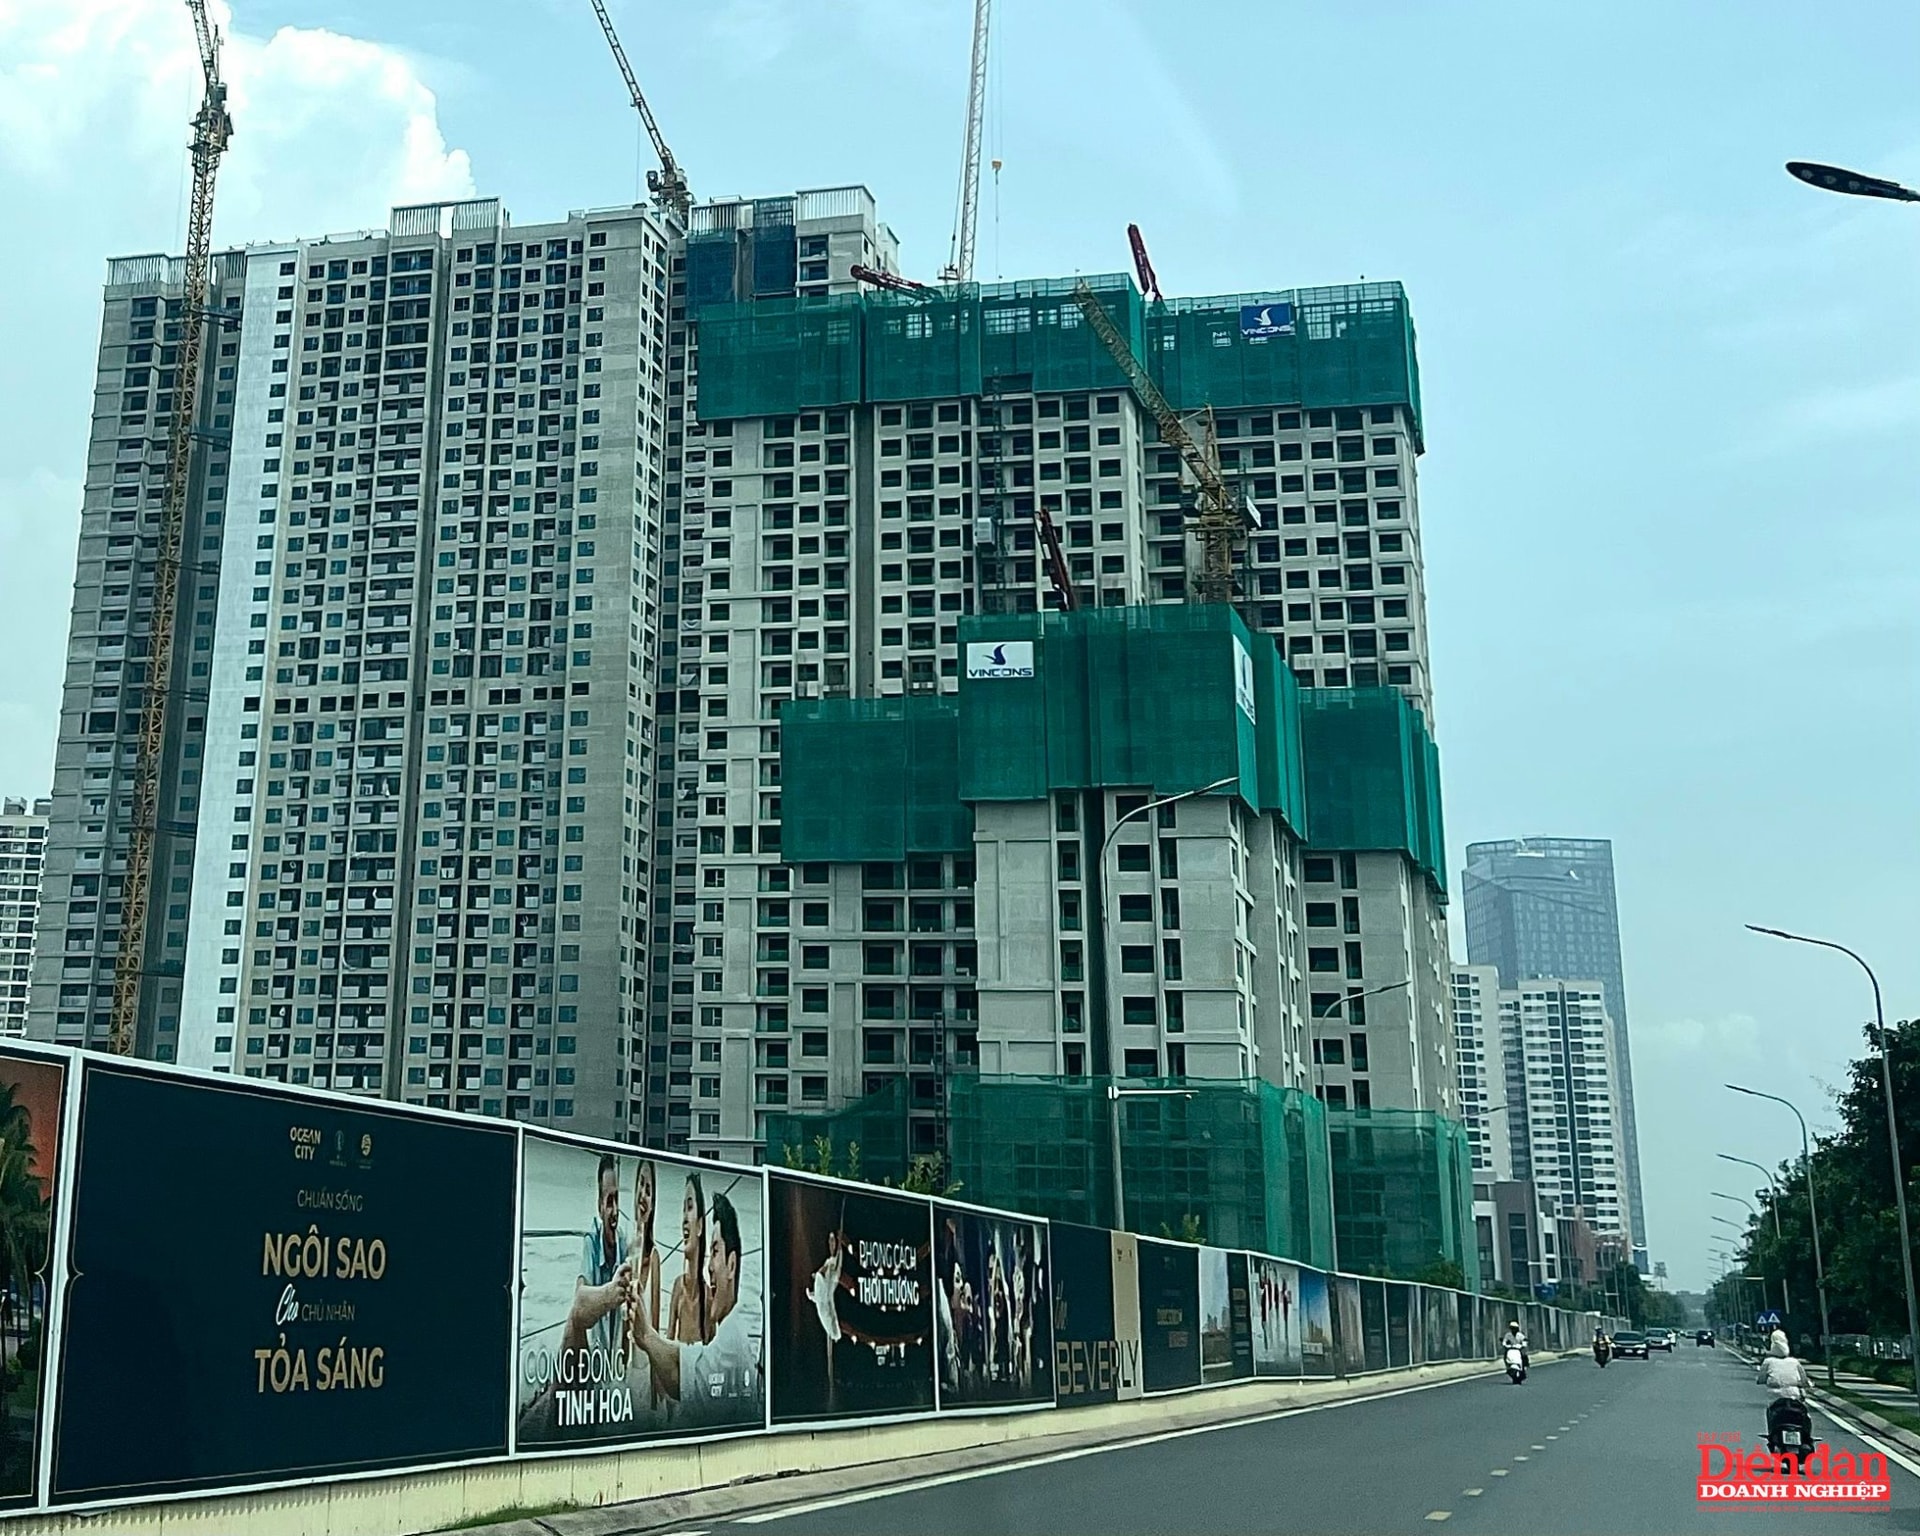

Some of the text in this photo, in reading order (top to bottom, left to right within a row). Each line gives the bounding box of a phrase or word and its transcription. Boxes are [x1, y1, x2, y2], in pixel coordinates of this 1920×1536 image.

[1241, 325, 1292, 335] VINCONS
[968, 668, 1033, 677] VINCONS
[289, 1126, 321, 1144] OCEAN
[294, 1144, 315, 1160] CITY
[262, 1224, 386, 1280] NGÔI SAO
[859, 1238, 917, 1271] PHONG CÁCH
[275, 1283, 299, 1326] Cho
[254, 1332, 384, 1393] TỎA SÁNG
[1056, 1339, 1139, 1395] BEVERLY
[555, 1387, 633, 1426] TINH HOA
